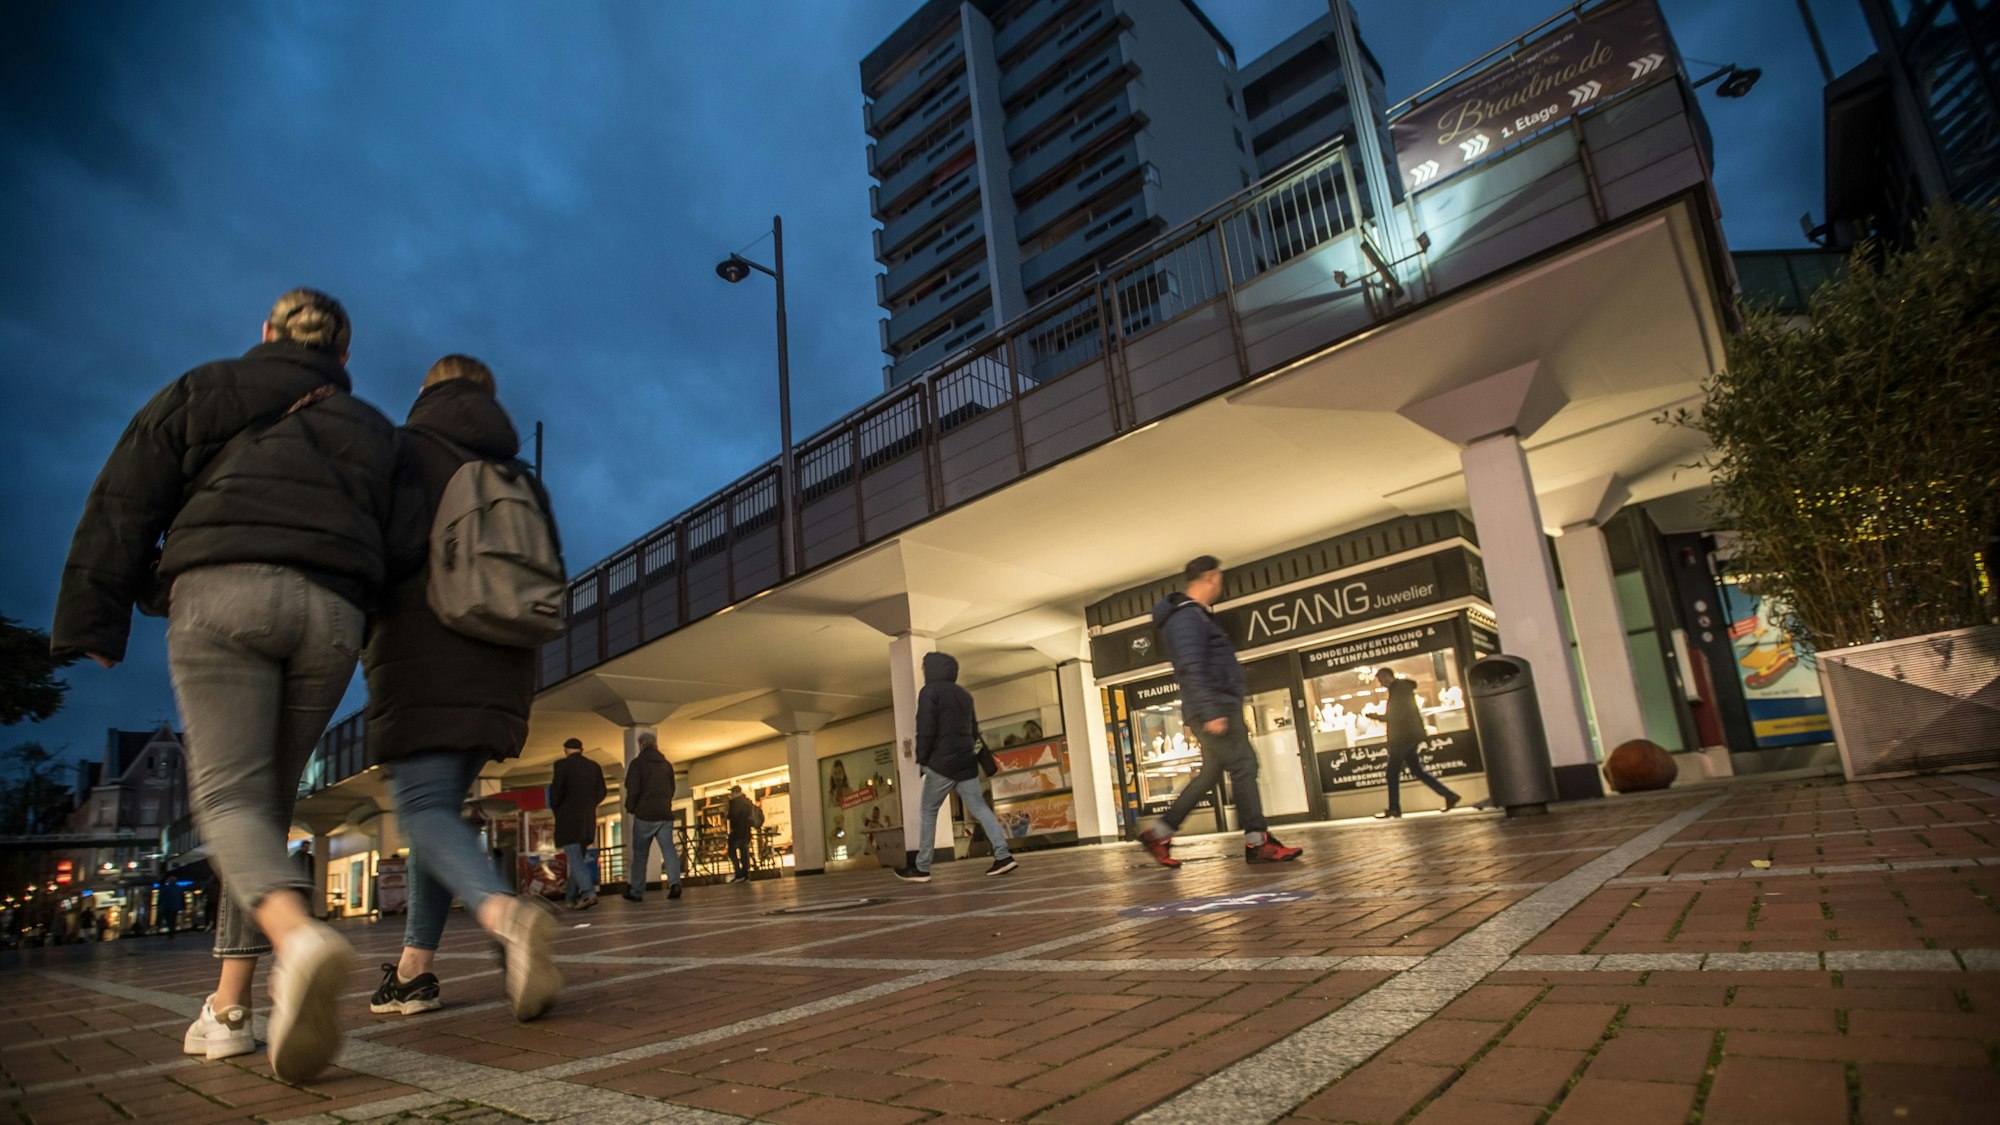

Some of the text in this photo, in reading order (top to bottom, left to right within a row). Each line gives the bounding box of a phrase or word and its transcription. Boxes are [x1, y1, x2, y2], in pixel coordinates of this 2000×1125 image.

[1437, 40, 1613, 145] Brautmode
[1501, 103, 1559, 138] 1. Etage
[1248, 582, 1434, 641] ASANG Juwelier
[1309, 627, 1436, 662] SONDERANFERTIGUNG &
[1327, 640, 1419, 667] STEINFASSUNGEN
[1137, 683, 1180, 699] TRAURIN
[1333, 769, 1403, 784] LASERSCHWEI
